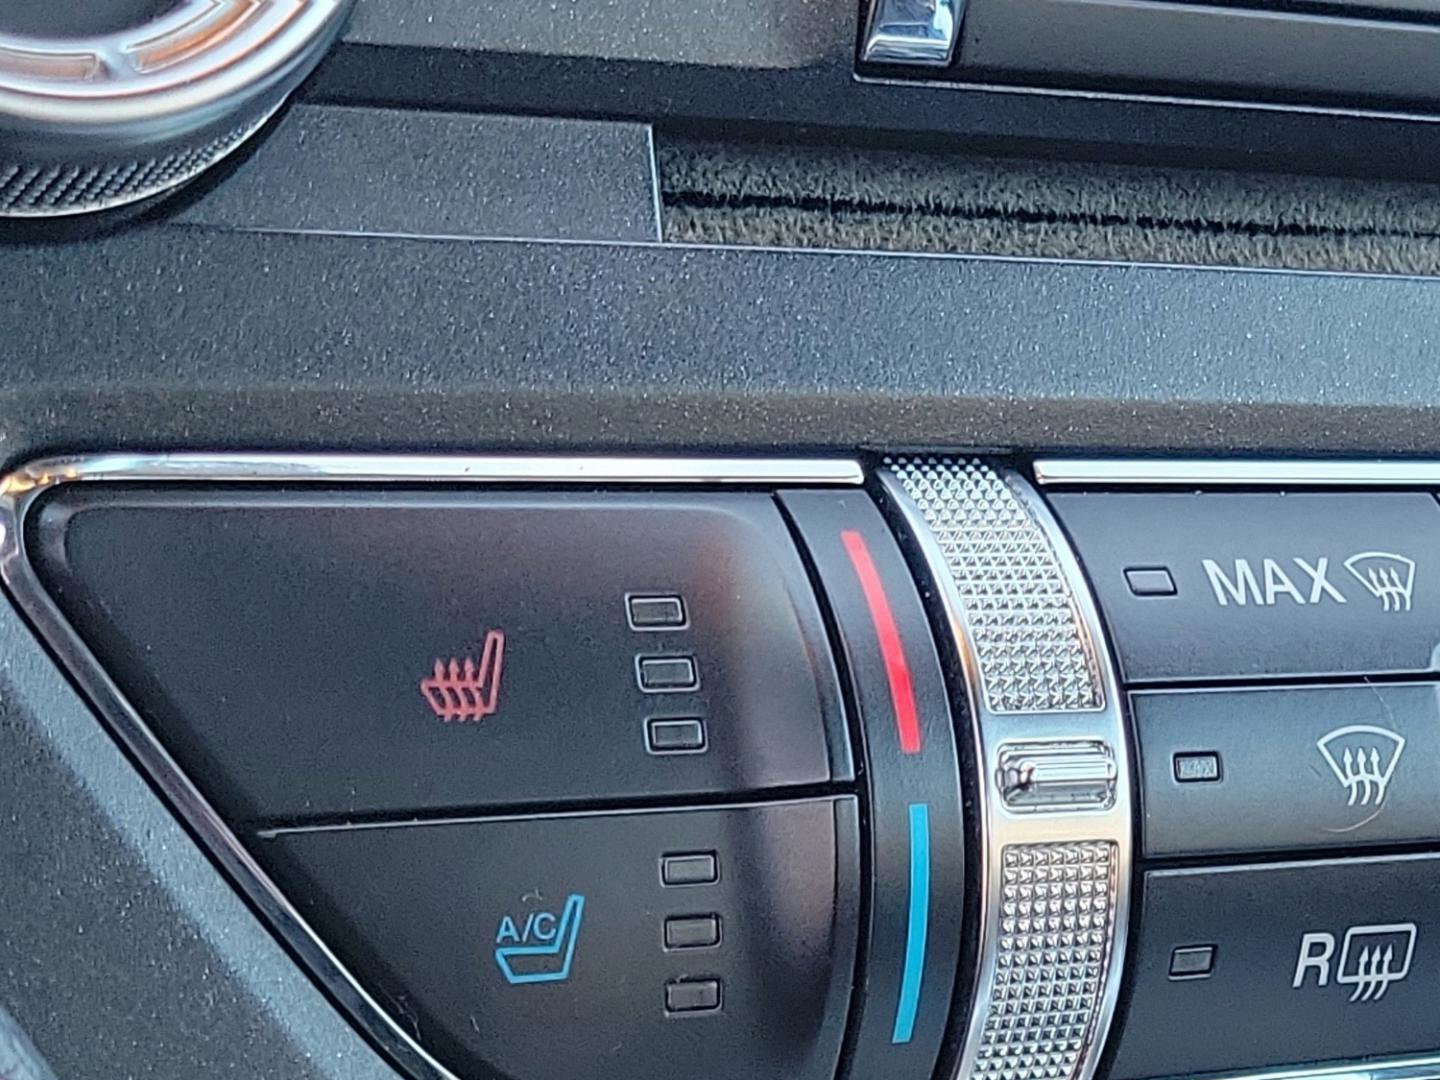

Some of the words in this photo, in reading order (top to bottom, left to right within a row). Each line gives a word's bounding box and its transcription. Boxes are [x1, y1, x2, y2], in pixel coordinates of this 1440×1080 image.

[1201, 556, 1347, 606] MAX
[495, 911, 557, 944] A/C
[1292, 932, 1336, 988] R
